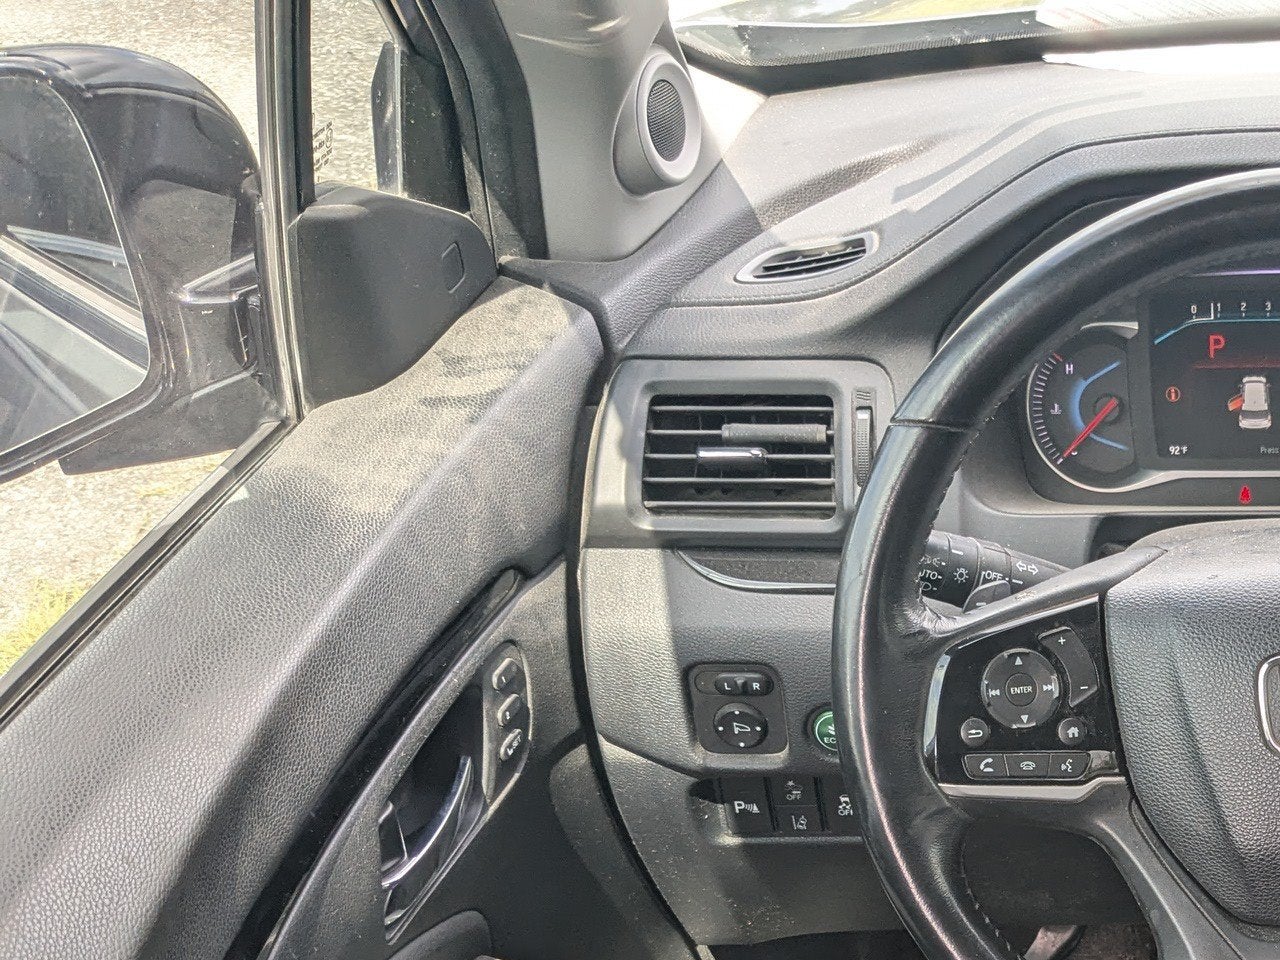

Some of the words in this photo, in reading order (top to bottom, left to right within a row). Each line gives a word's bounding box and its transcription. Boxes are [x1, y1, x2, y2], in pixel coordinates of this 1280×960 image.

[1190, 304, 1198, 314] 0
[1216, 302, 1222, 311] 1
[1240, 302, 1248, 311] 2
[1264, 302, 1272, 311] 3
[1207, 334, 1225, 359] P
[1065, 364, 1074, 375] H
[1260, 446, 1279, 454] Press
[918, 568, 938, 580] UTO
[985, 570, 1003, 581] OFF
[724, 682, 731, 690] L
[752, 682, 760, 690] R
[1010, 686, 1033, 695] ENTER
[823, 736, 837, 744] EC
